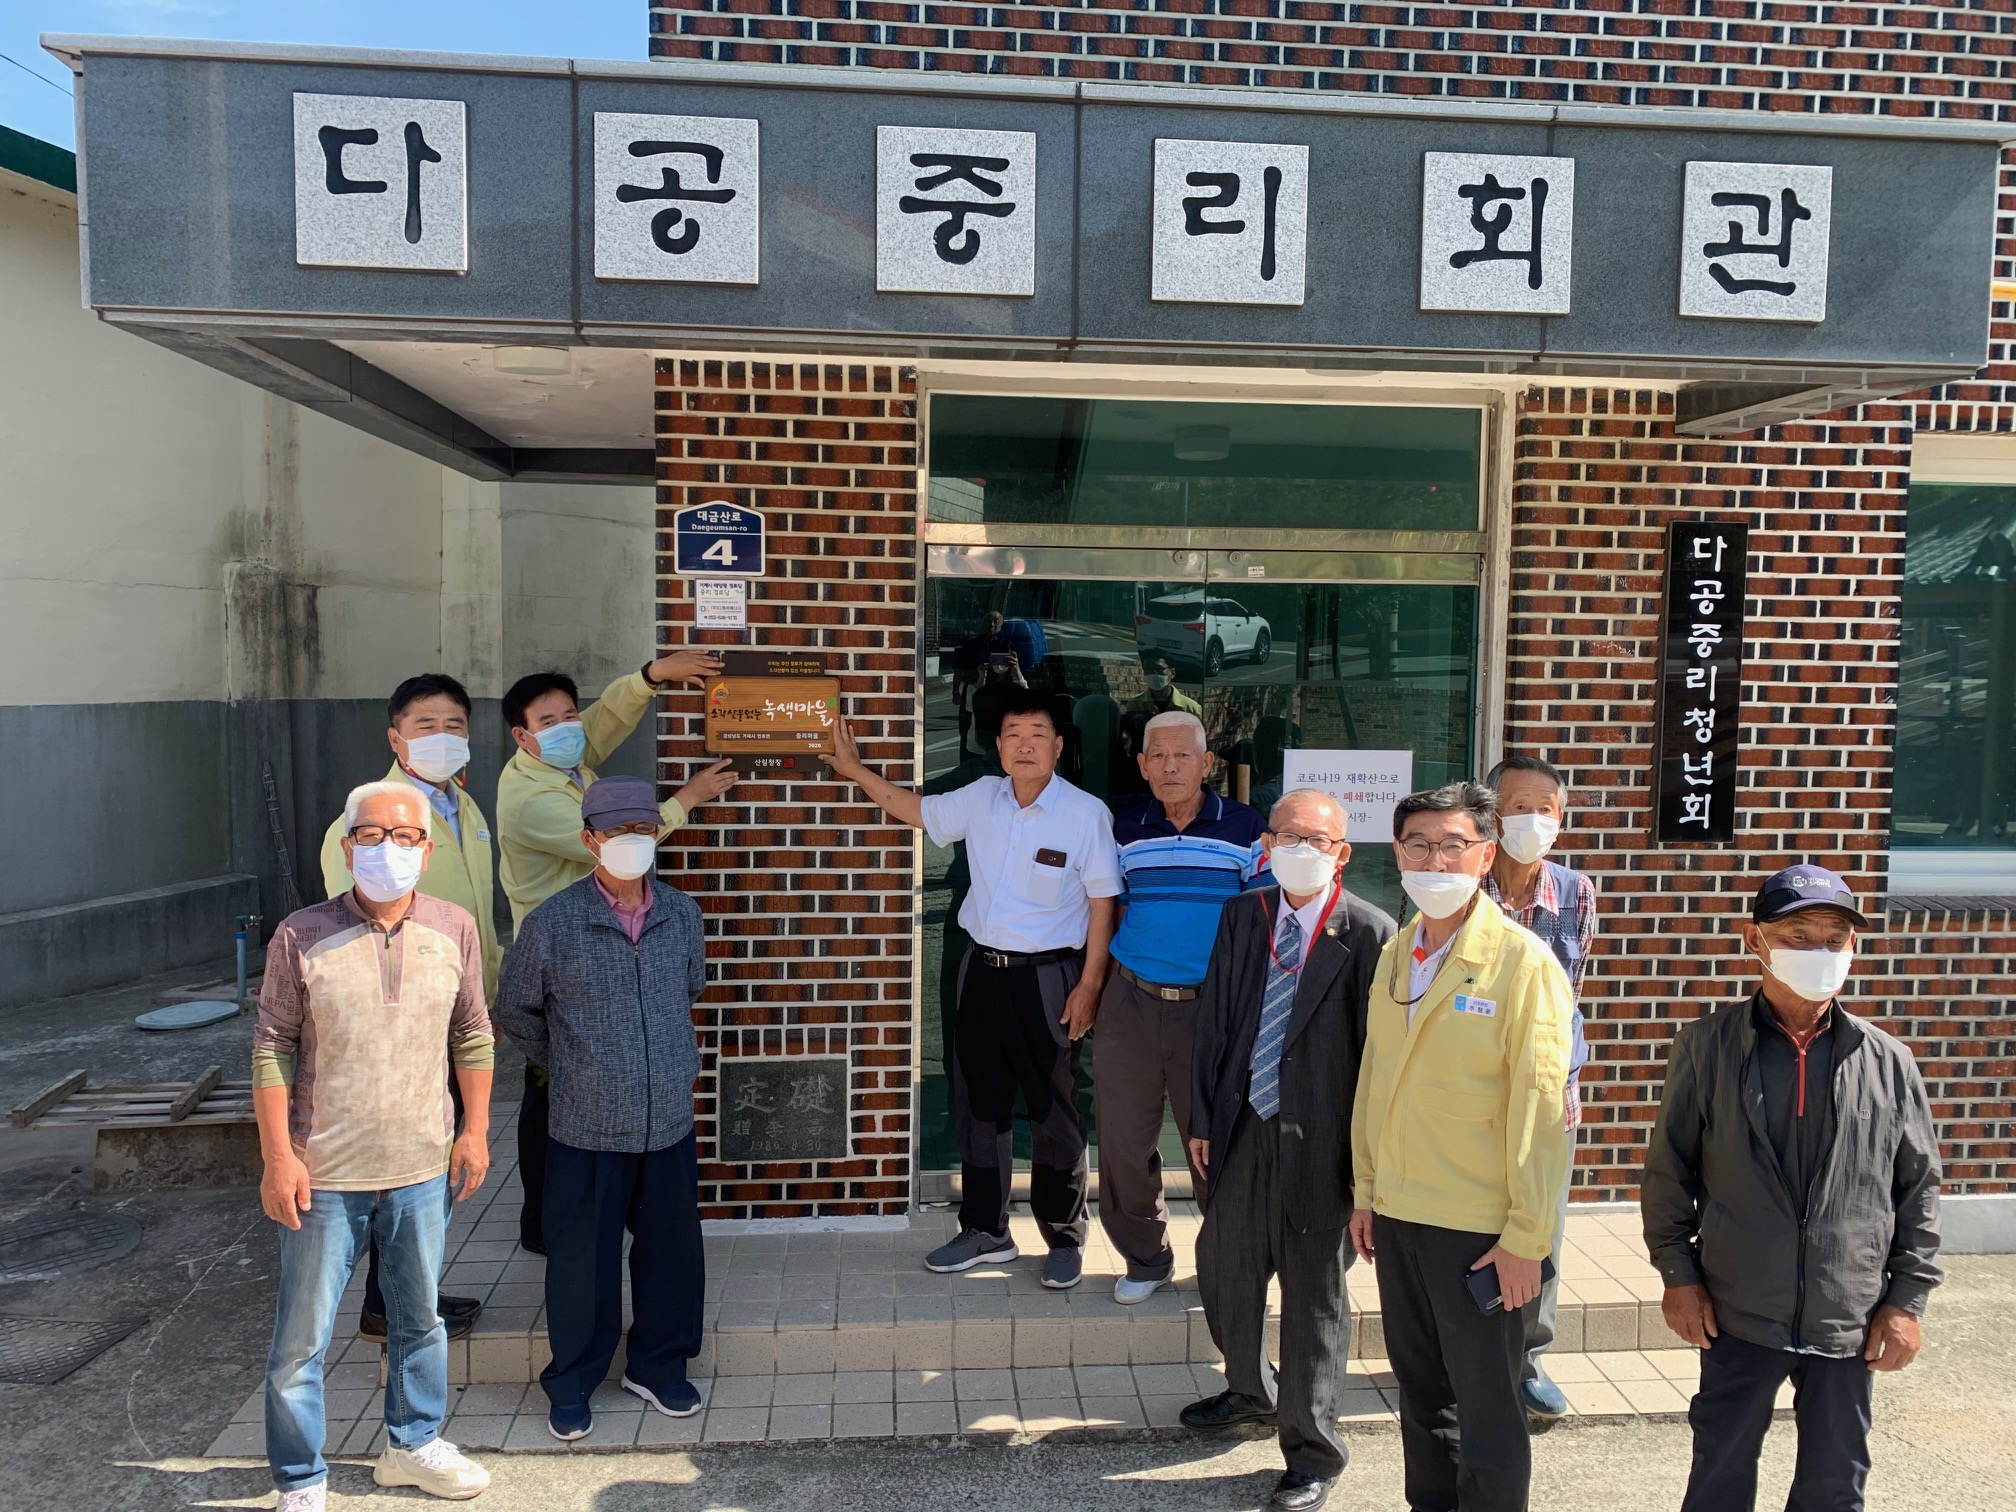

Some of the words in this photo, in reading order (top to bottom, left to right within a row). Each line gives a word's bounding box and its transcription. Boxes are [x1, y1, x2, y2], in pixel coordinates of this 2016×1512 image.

[318, 120, 1812, 296] 다공중리회관
[697, 510, 742, 522] 대금산로
[691, 523, 748, 532] Daegeumsan-ro
[701, 539, 738, 566] 4
[1678, 535, 1728, 829] 다공중리청년회
[762, 698, 833, 727] 녹색마을
[796, 732, 819, 740] 중리마을
[754, 757, 782, 768] 산림청장
[1296, 773, 1341, 784] 코로나19
[1345, 773, 1400, 784] 재확산으로
[443, 905, 454, 935] NEPA
[264, 995, 287, 1010] NEPA
[286, 992, 295, 1016] NEPA
